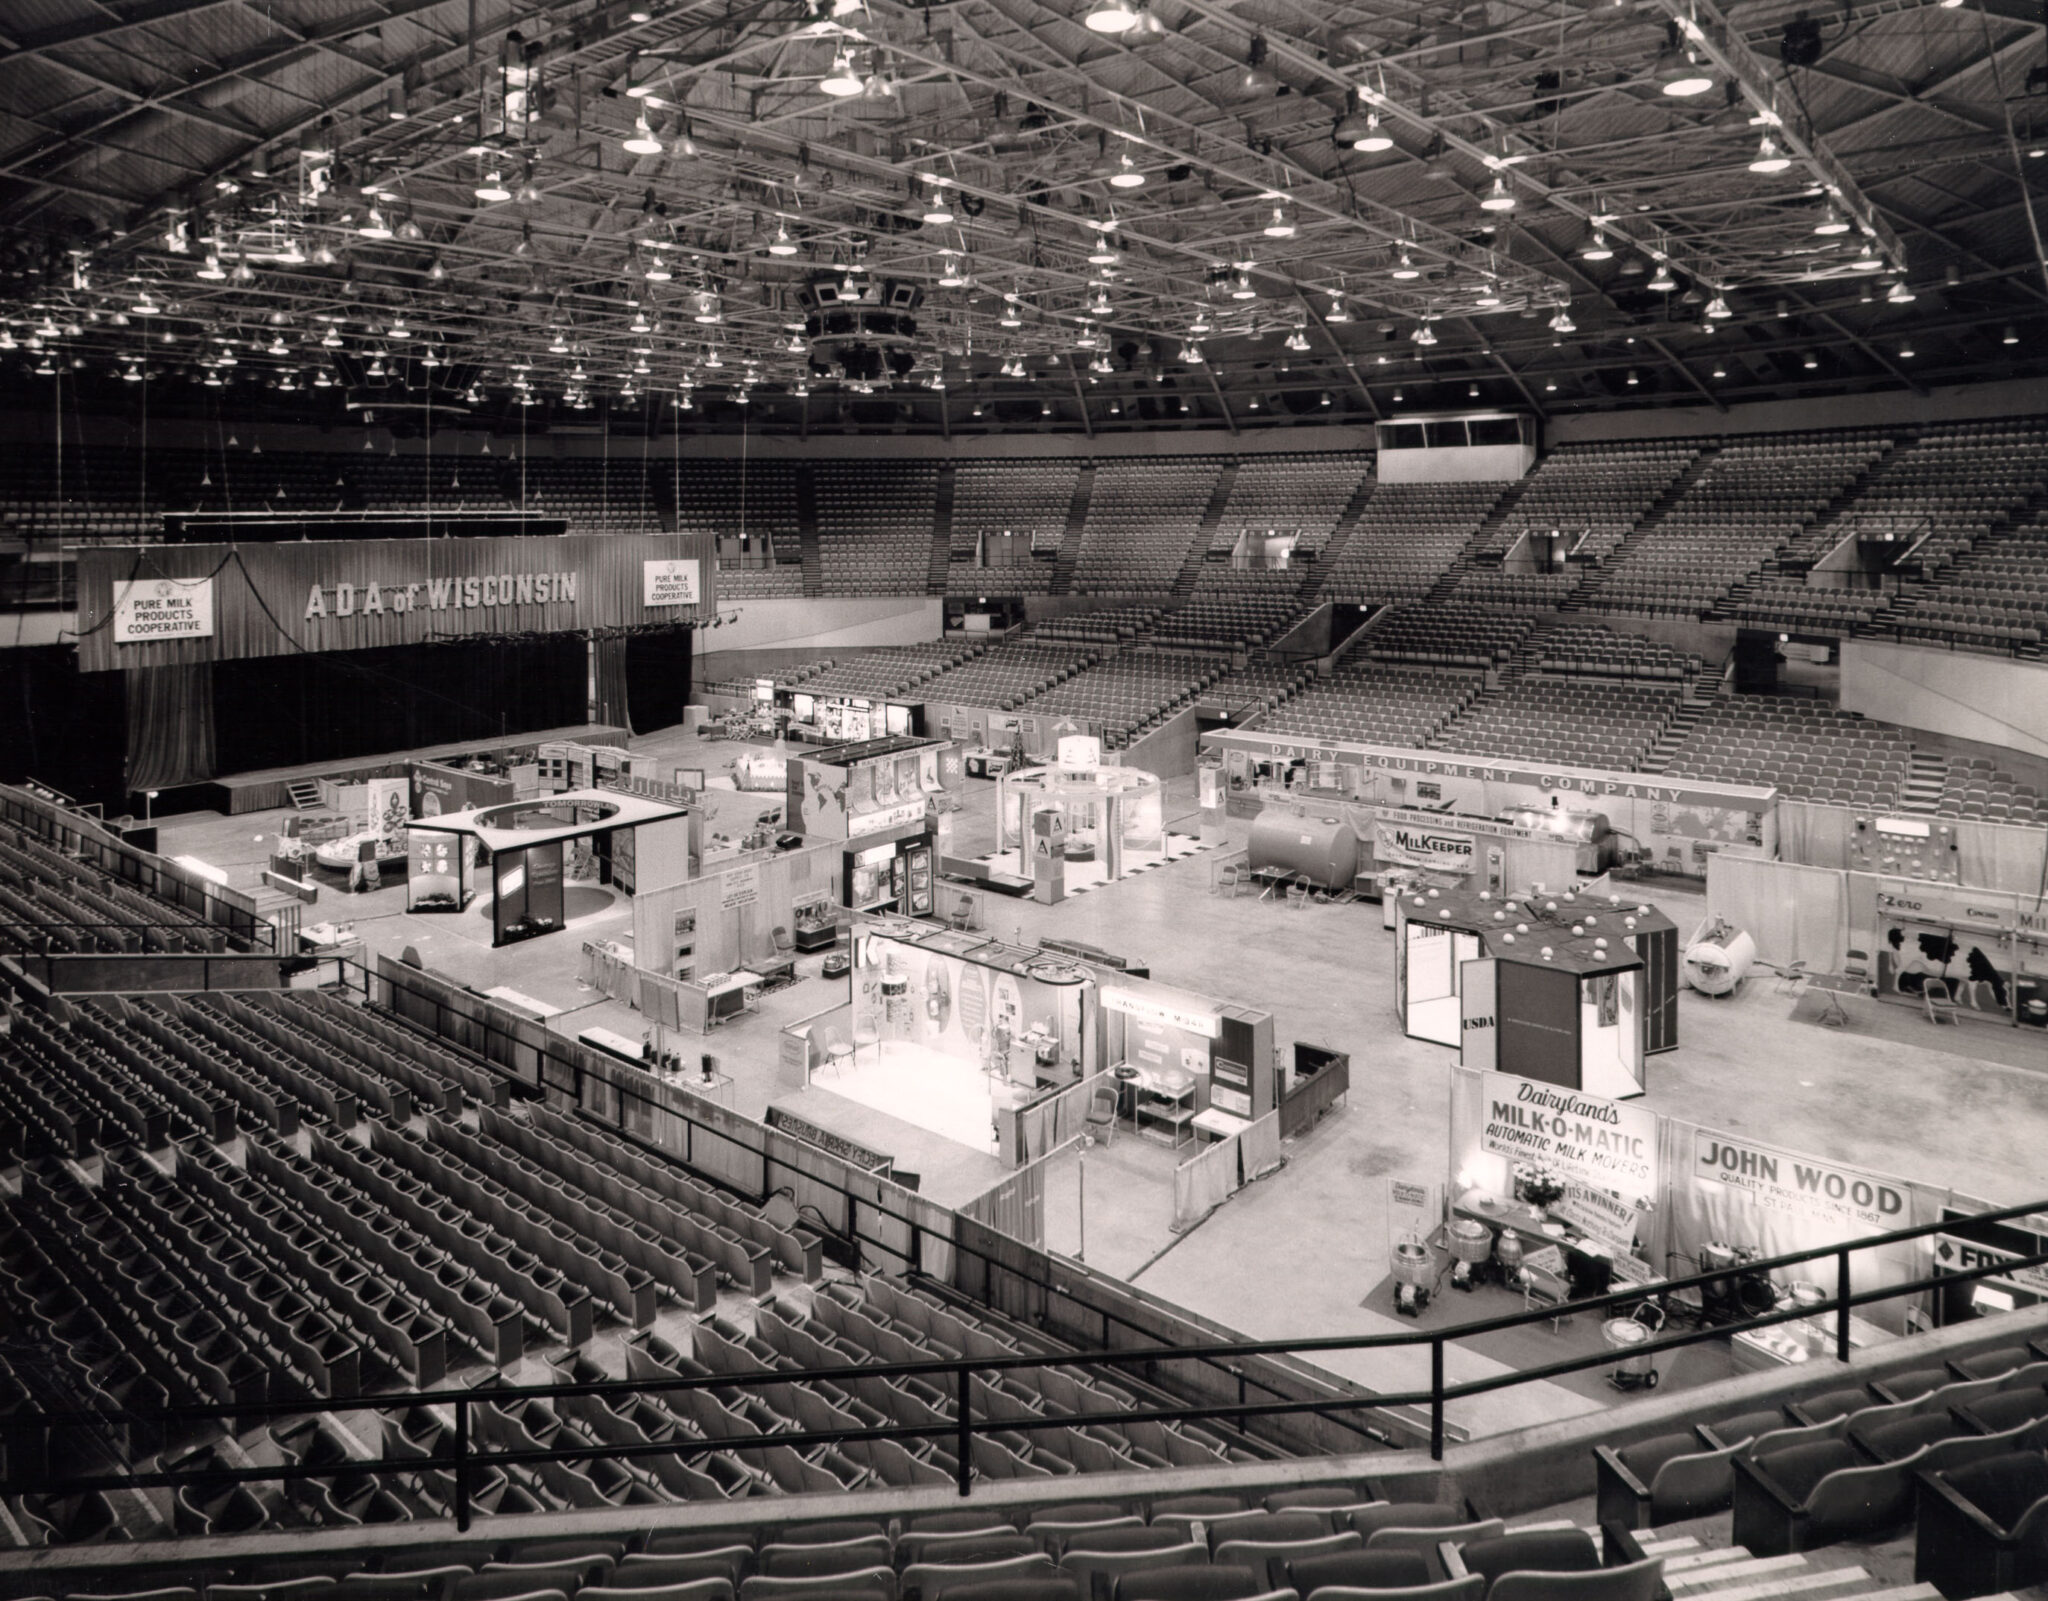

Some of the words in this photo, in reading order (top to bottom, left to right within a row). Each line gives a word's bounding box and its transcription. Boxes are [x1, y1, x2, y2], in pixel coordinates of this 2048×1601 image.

[655, 575, 671, 583] PURE
[673, 574, 689, 582] MILK
[393, 583, 419, 613] of
[426, 572, 577, 611] WISCONSIN
[656, 583, 689, 592] PRODUCTS
[134, 600, 162, 610] PURE
[167, 598, 192, 608] MILK
[652, 592, 693, 601] COOPERATIVE
[135, 610, 193, 621] PRODUCTS
[127, 620, 201, 634] COOPERATIVE
[1272, 744, 1339, 762] DAIRY
[1364, 755, 1512, 781] EQUIPMENT
[1540, 775, 1682, 802] COMPANY
[1052, 816, 1063, 832] A
[1393, 812, 1408, 821] FOOD
[1409, 813, 1442, 826] PROCESSING
[1457, 820, 1498, 834] REFRIGERATION
[1500, 827, 1532, 838] EQUIPMENT
[1037, 840, 1049, 855] A
[1887, 896, 1922, 911] Zero
[1463, 1016, 1495, 1030] USDA
[1517, 1082, 1621, 1125] Dairyland's
[1486, 1123, 1551, 1151] AUTOMATIC
[1556, 1142, 1587, 1161] MILK
[1592, 1152, 1649, 1180] MOVERS
[1701, 1142, 1778, 1183] JOHN
[1794, 1164, 1903, 1215] WOOD
[1720, 1172, 1764, 1191] QUALITY
[1769, 1185, 1821, 1207] PRODUCTS
[1856, 1209, 1881, 1224] 1867
[1764, 1197, 1778, 1208] ST
